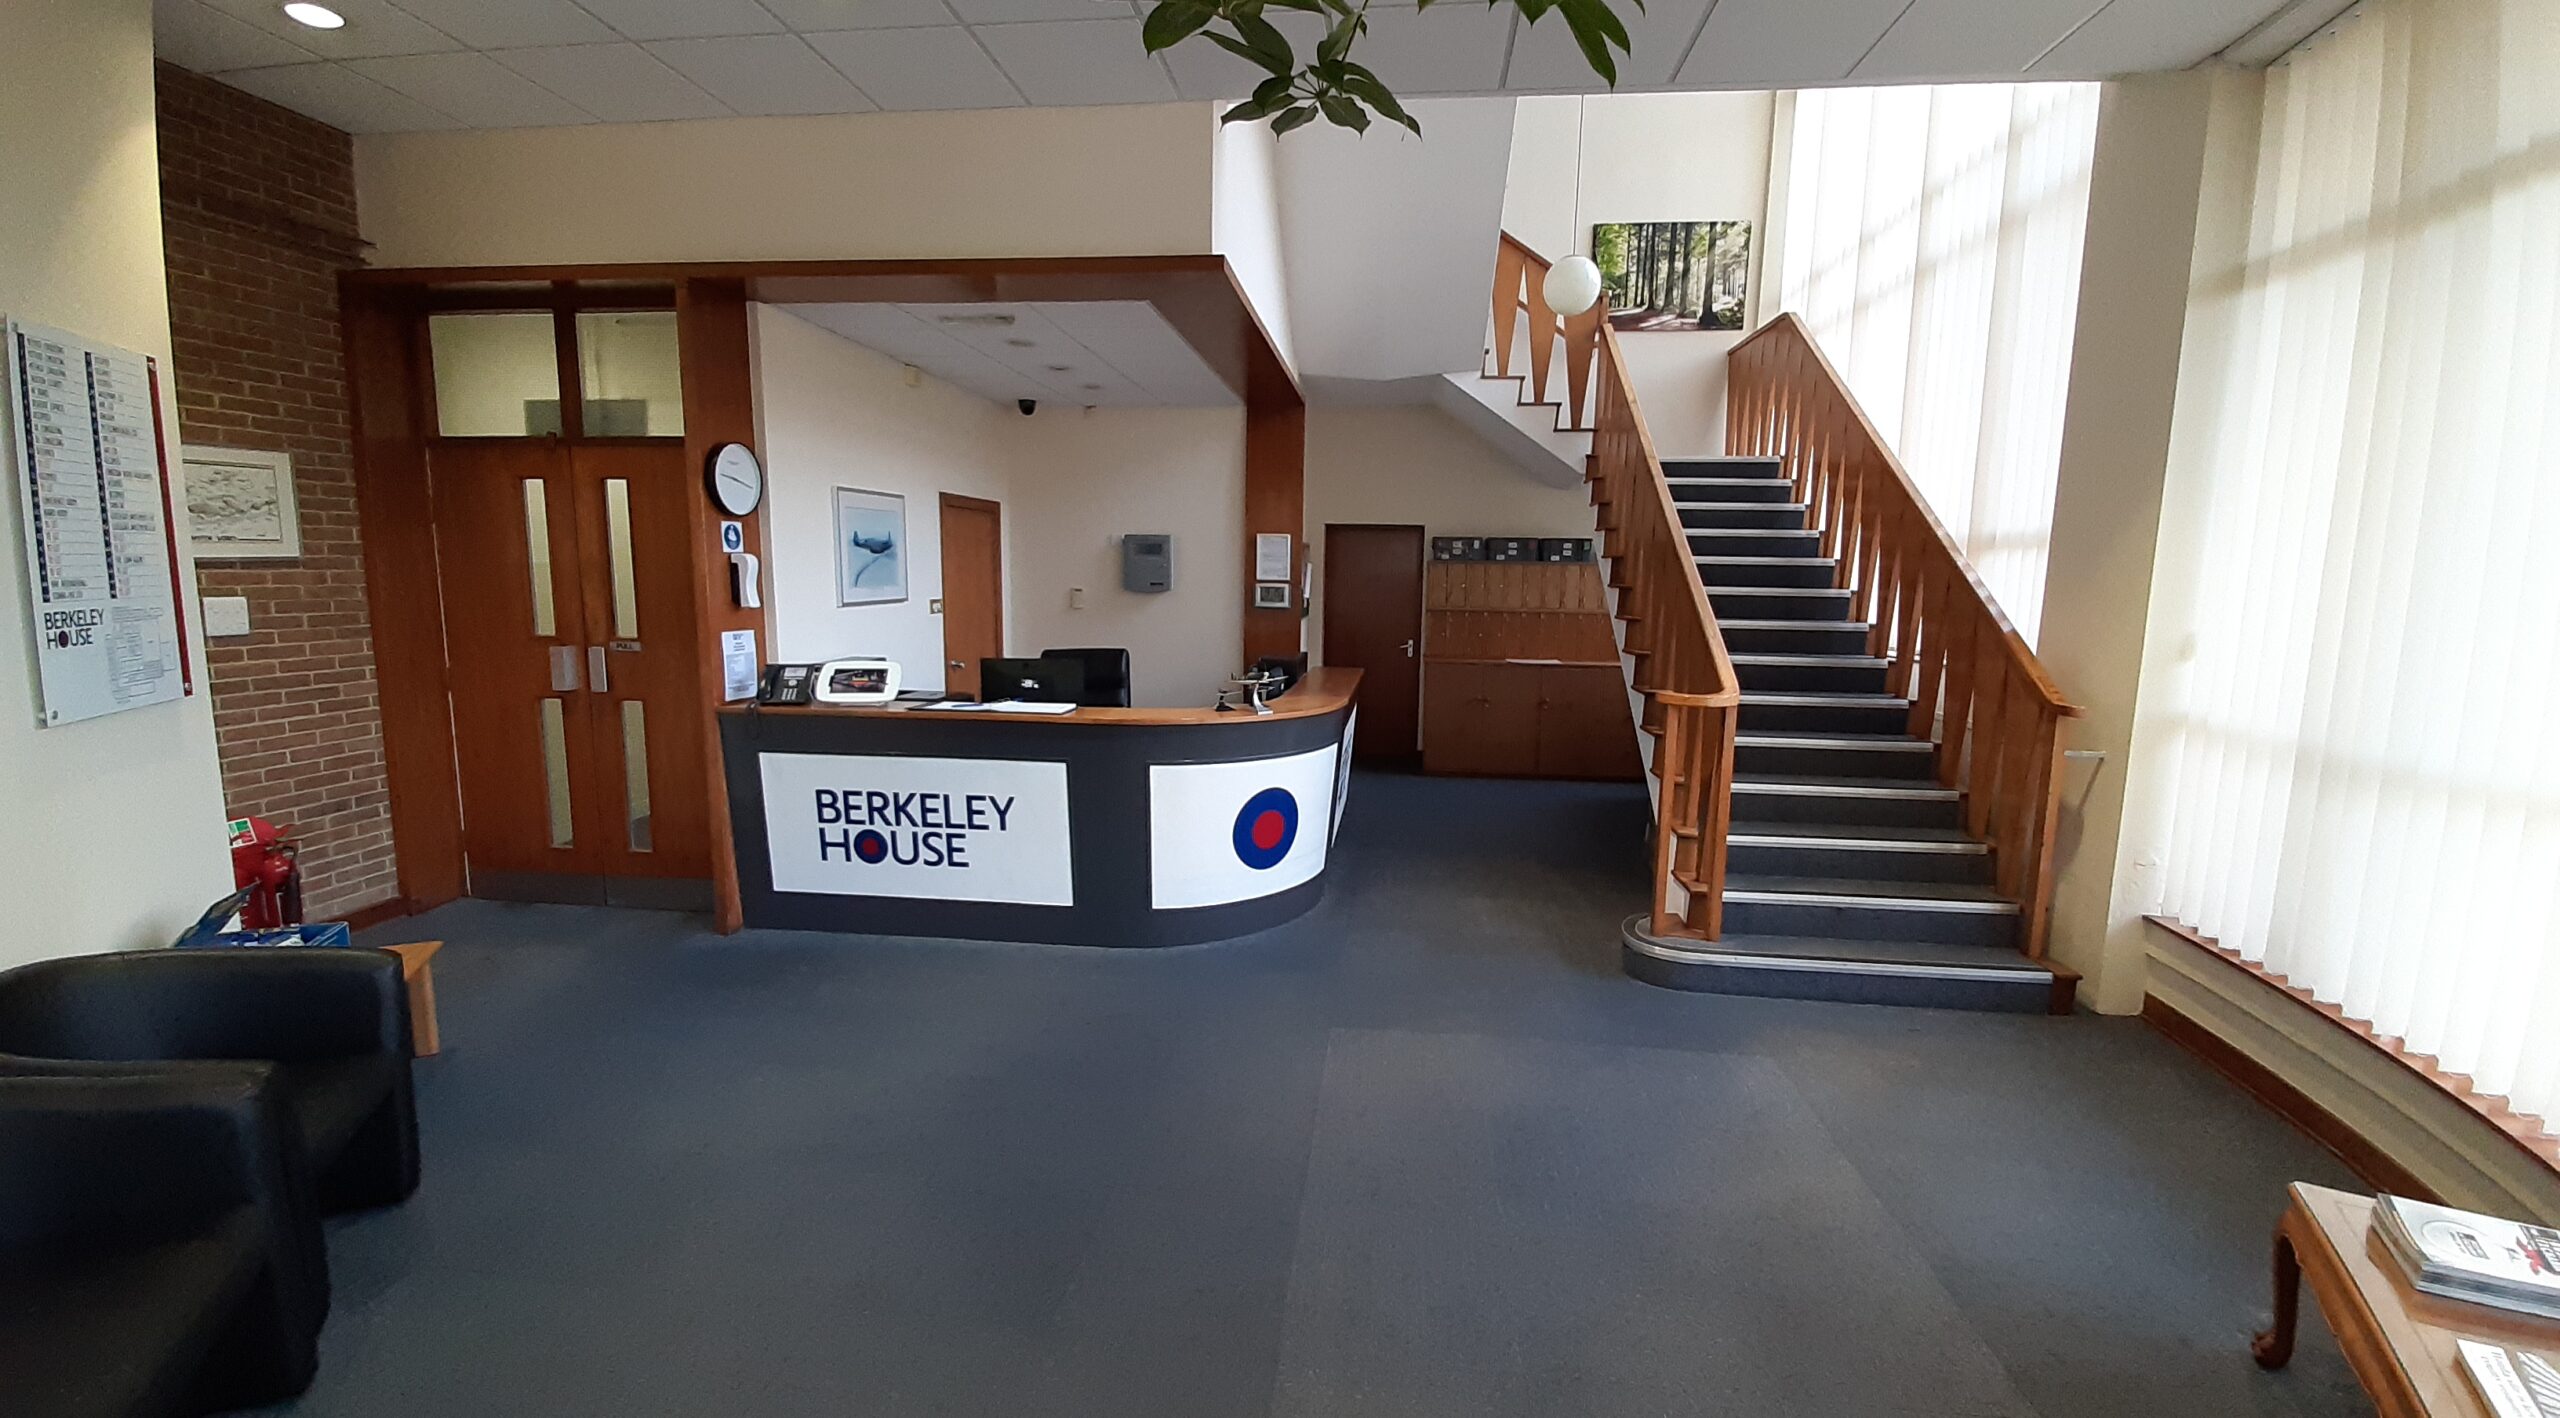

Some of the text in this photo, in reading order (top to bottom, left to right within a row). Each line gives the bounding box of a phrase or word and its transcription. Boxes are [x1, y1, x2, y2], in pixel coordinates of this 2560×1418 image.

[44, 608, 104, 631] BERKELEY
[46, 627, 94, 650] HOUSE
[815, 789, 1014, 831] BERKELEY
[819, 828, 969, 867] HOUSE
